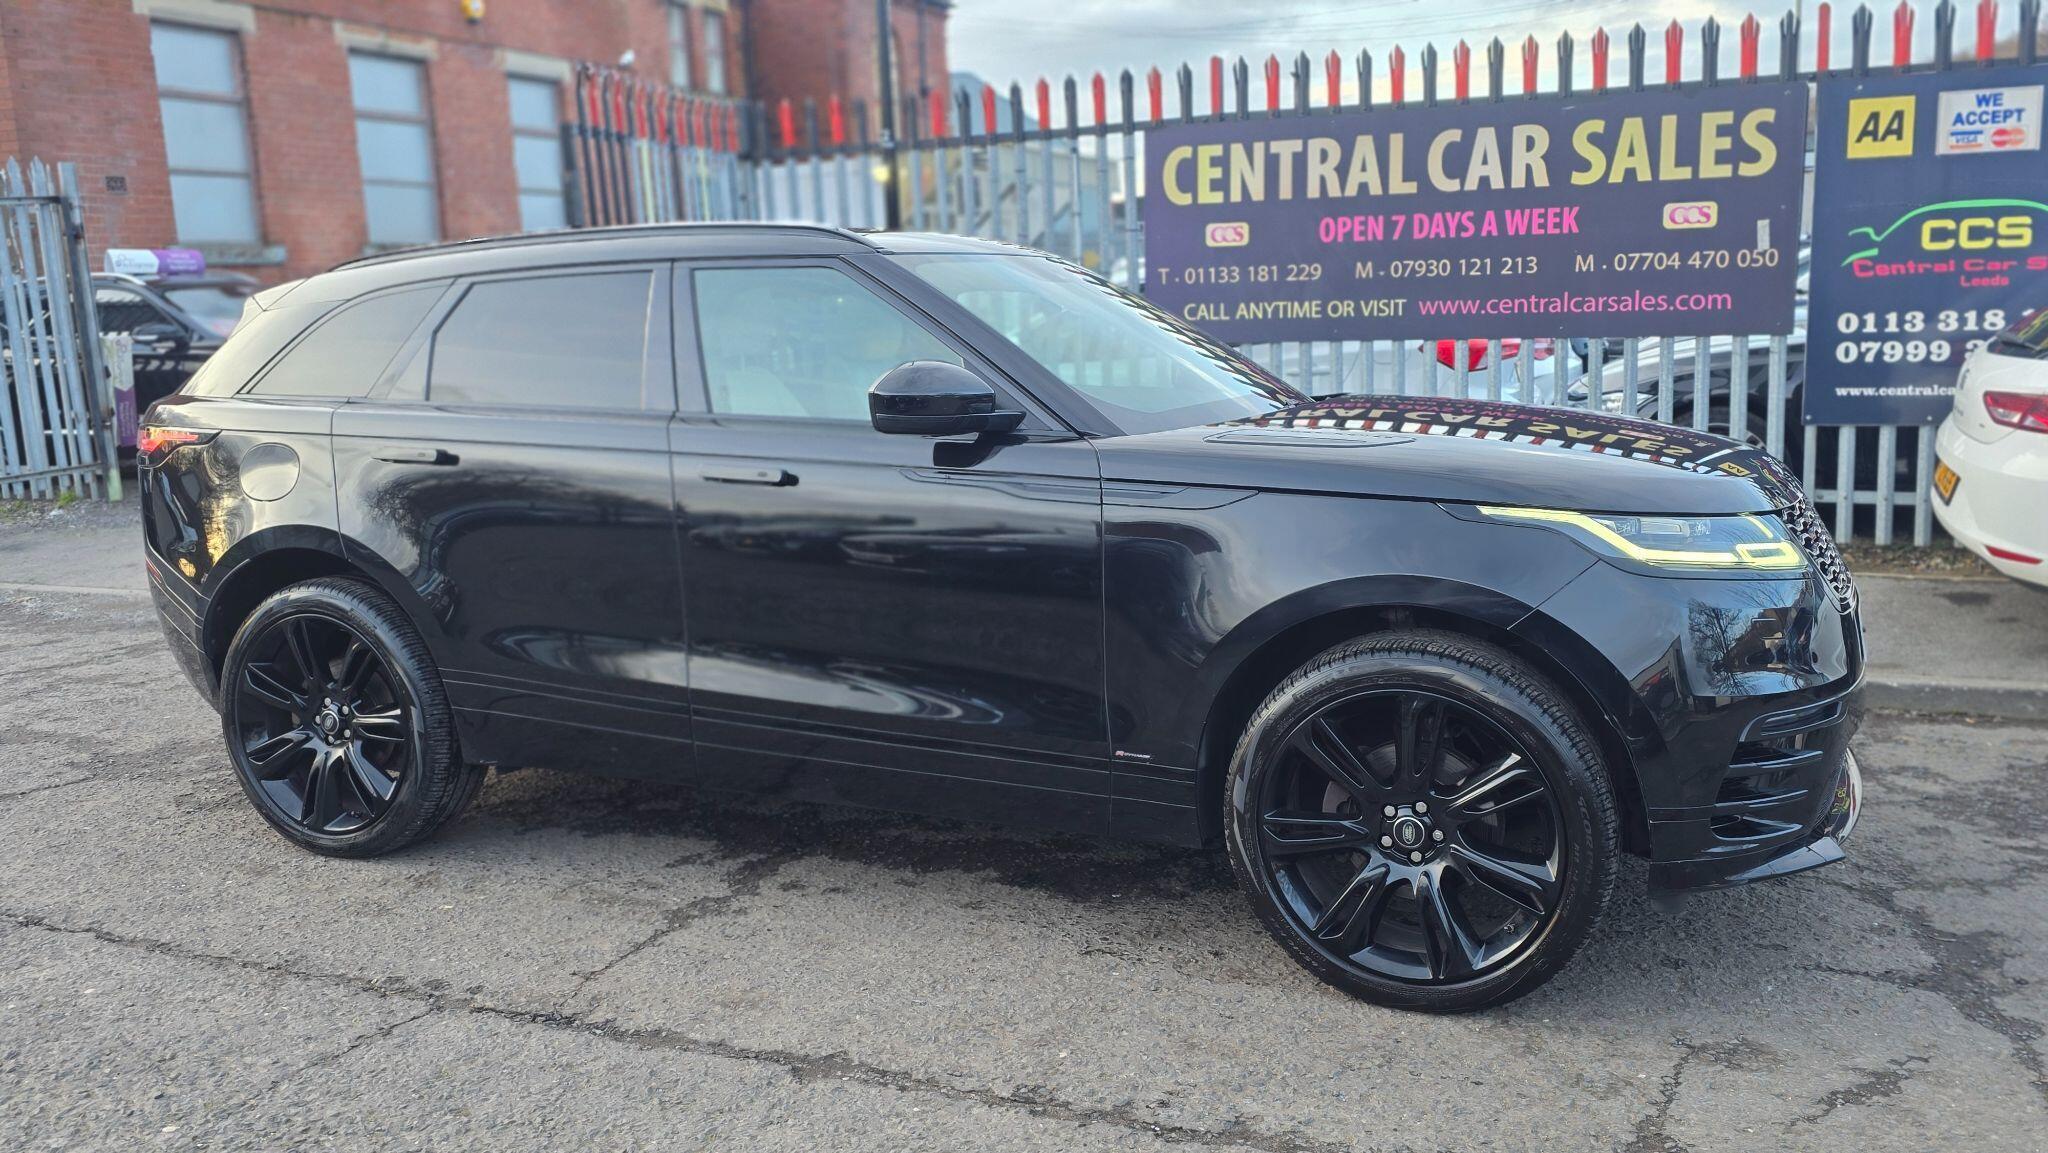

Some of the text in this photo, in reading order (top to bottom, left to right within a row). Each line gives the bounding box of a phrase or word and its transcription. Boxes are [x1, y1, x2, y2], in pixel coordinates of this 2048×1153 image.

[1975, 93, 2004, 108] WE
[1854, 109, 1906, 144] AA
[1952, 108, 2026, 127] ACCEPT
[1162, 108, 1778, 206] CENTRAL CAR SALES
[1319, 206, 1580, 243] OPEN 7 DAYS A WEEK
[1920, 216, 2033, 250] CCS
[1390, 259, 1451, 278] 07930
[1459, 258, 1492, 276] 121
[1501, 256, 1538, 275] 213
[1614, 252, 1681, 271] 07704
[1687, 250, 1730, 269] 470
[1736, 248, 1779, 268] 050
[1853, 258, 1956, 277] Central
[1963, 258, 2018, 271] Car
[1184, 266, 1241, 284] 01133
[1248, 265, 1279, 282] 181
[1286, 264, 1323, 281] 229
[1960, 275, 2010, 287] Leeds
[1184, 299, 1407, 321] CALL ANYTIME OR VISIT
[1419, 290, 1732, 316] www.centralcarsales.com
[1837, 309, 2006, 333] 0113 318
[1835, 340, 1951, 363] 07999
